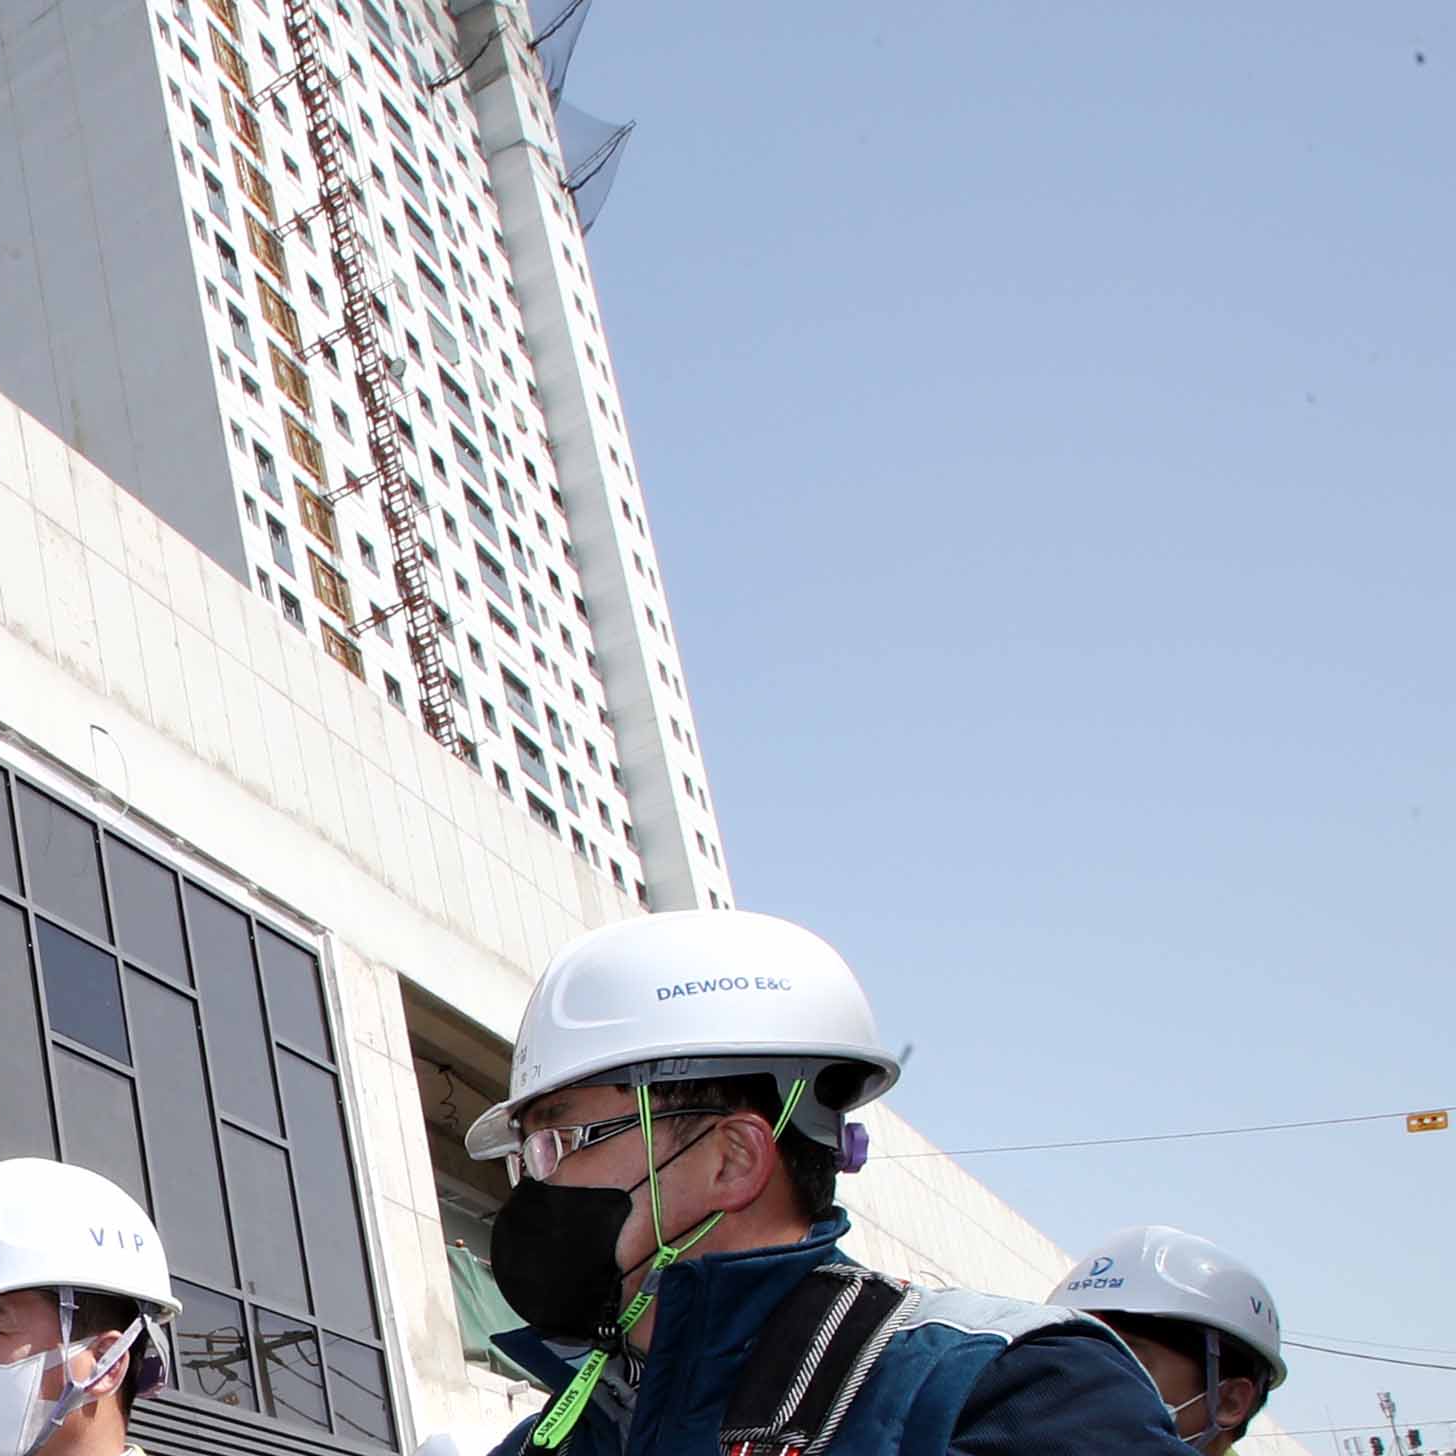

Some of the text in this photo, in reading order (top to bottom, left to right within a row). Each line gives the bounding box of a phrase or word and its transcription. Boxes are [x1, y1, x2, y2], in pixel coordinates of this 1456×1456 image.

[656, 976, 792, 1001] DAEWOO E&C
[89, 1227, 144, 1252] VIP
